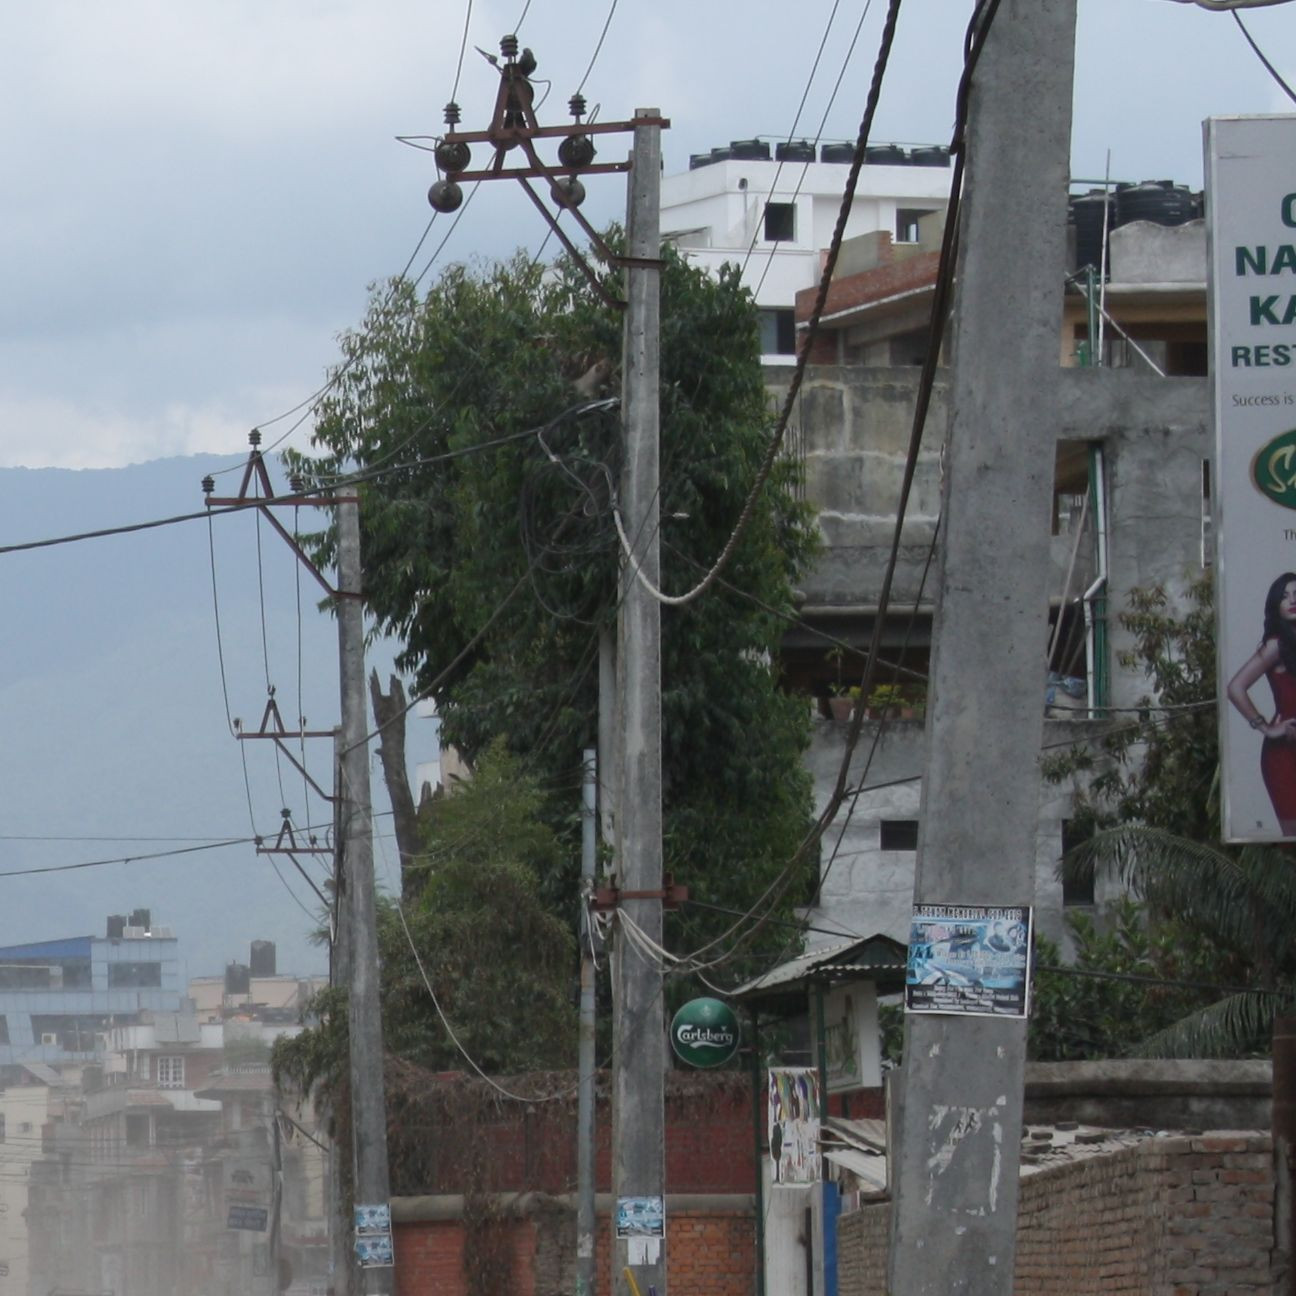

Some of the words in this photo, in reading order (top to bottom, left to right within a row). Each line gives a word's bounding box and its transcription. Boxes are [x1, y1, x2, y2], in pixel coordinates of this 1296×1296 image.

[1231, 345, 1296, 368] RES
[1232, 393, 1280, 407] Success
[1284, 391, 1295, 405] is
[677, 1024, 733, 1047] Carlsberg
